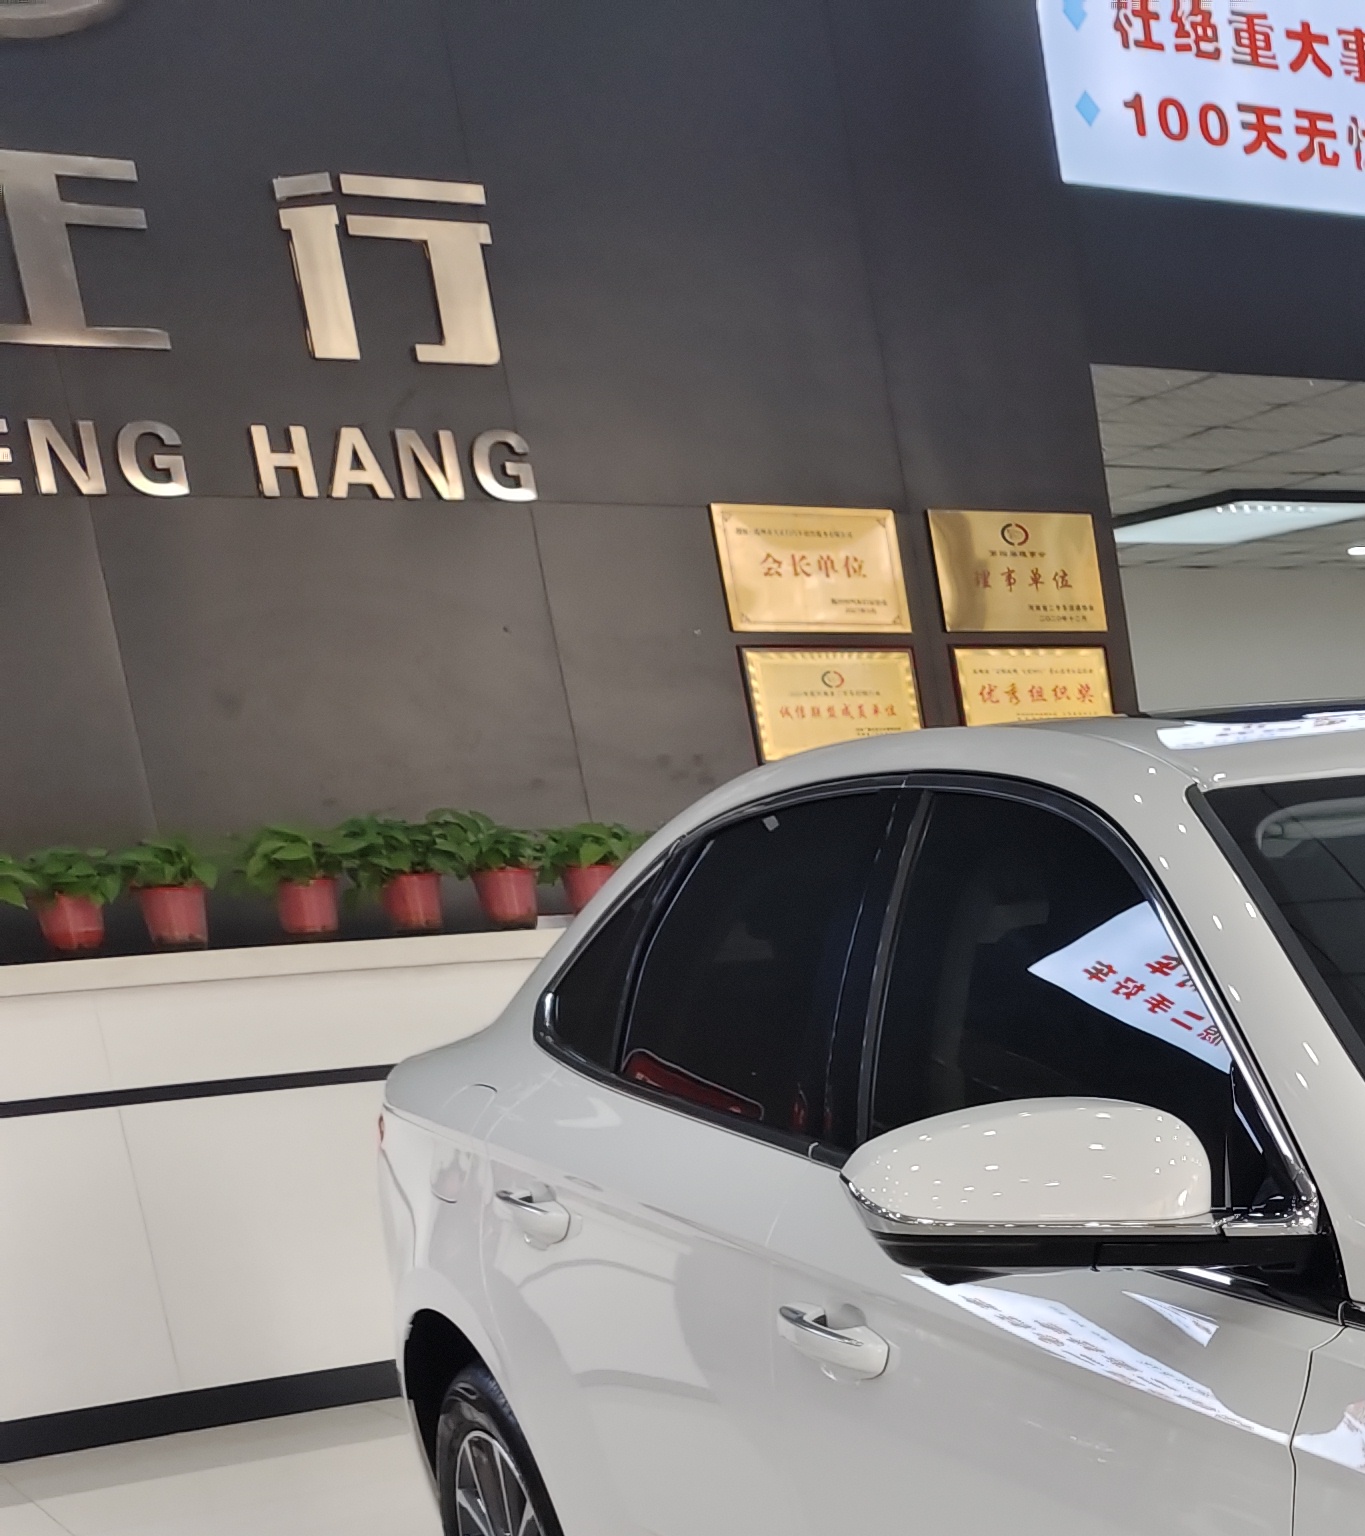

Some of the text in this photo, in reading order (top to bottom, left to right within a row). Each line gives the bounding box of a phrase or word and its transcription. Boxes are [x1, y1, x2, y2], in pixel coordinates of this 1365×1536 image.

[250, 423, 539, 503] HANG
[760, 552, 868, 580] 会长单位
[977, 682, 1095, 705] 优秀组织奖
